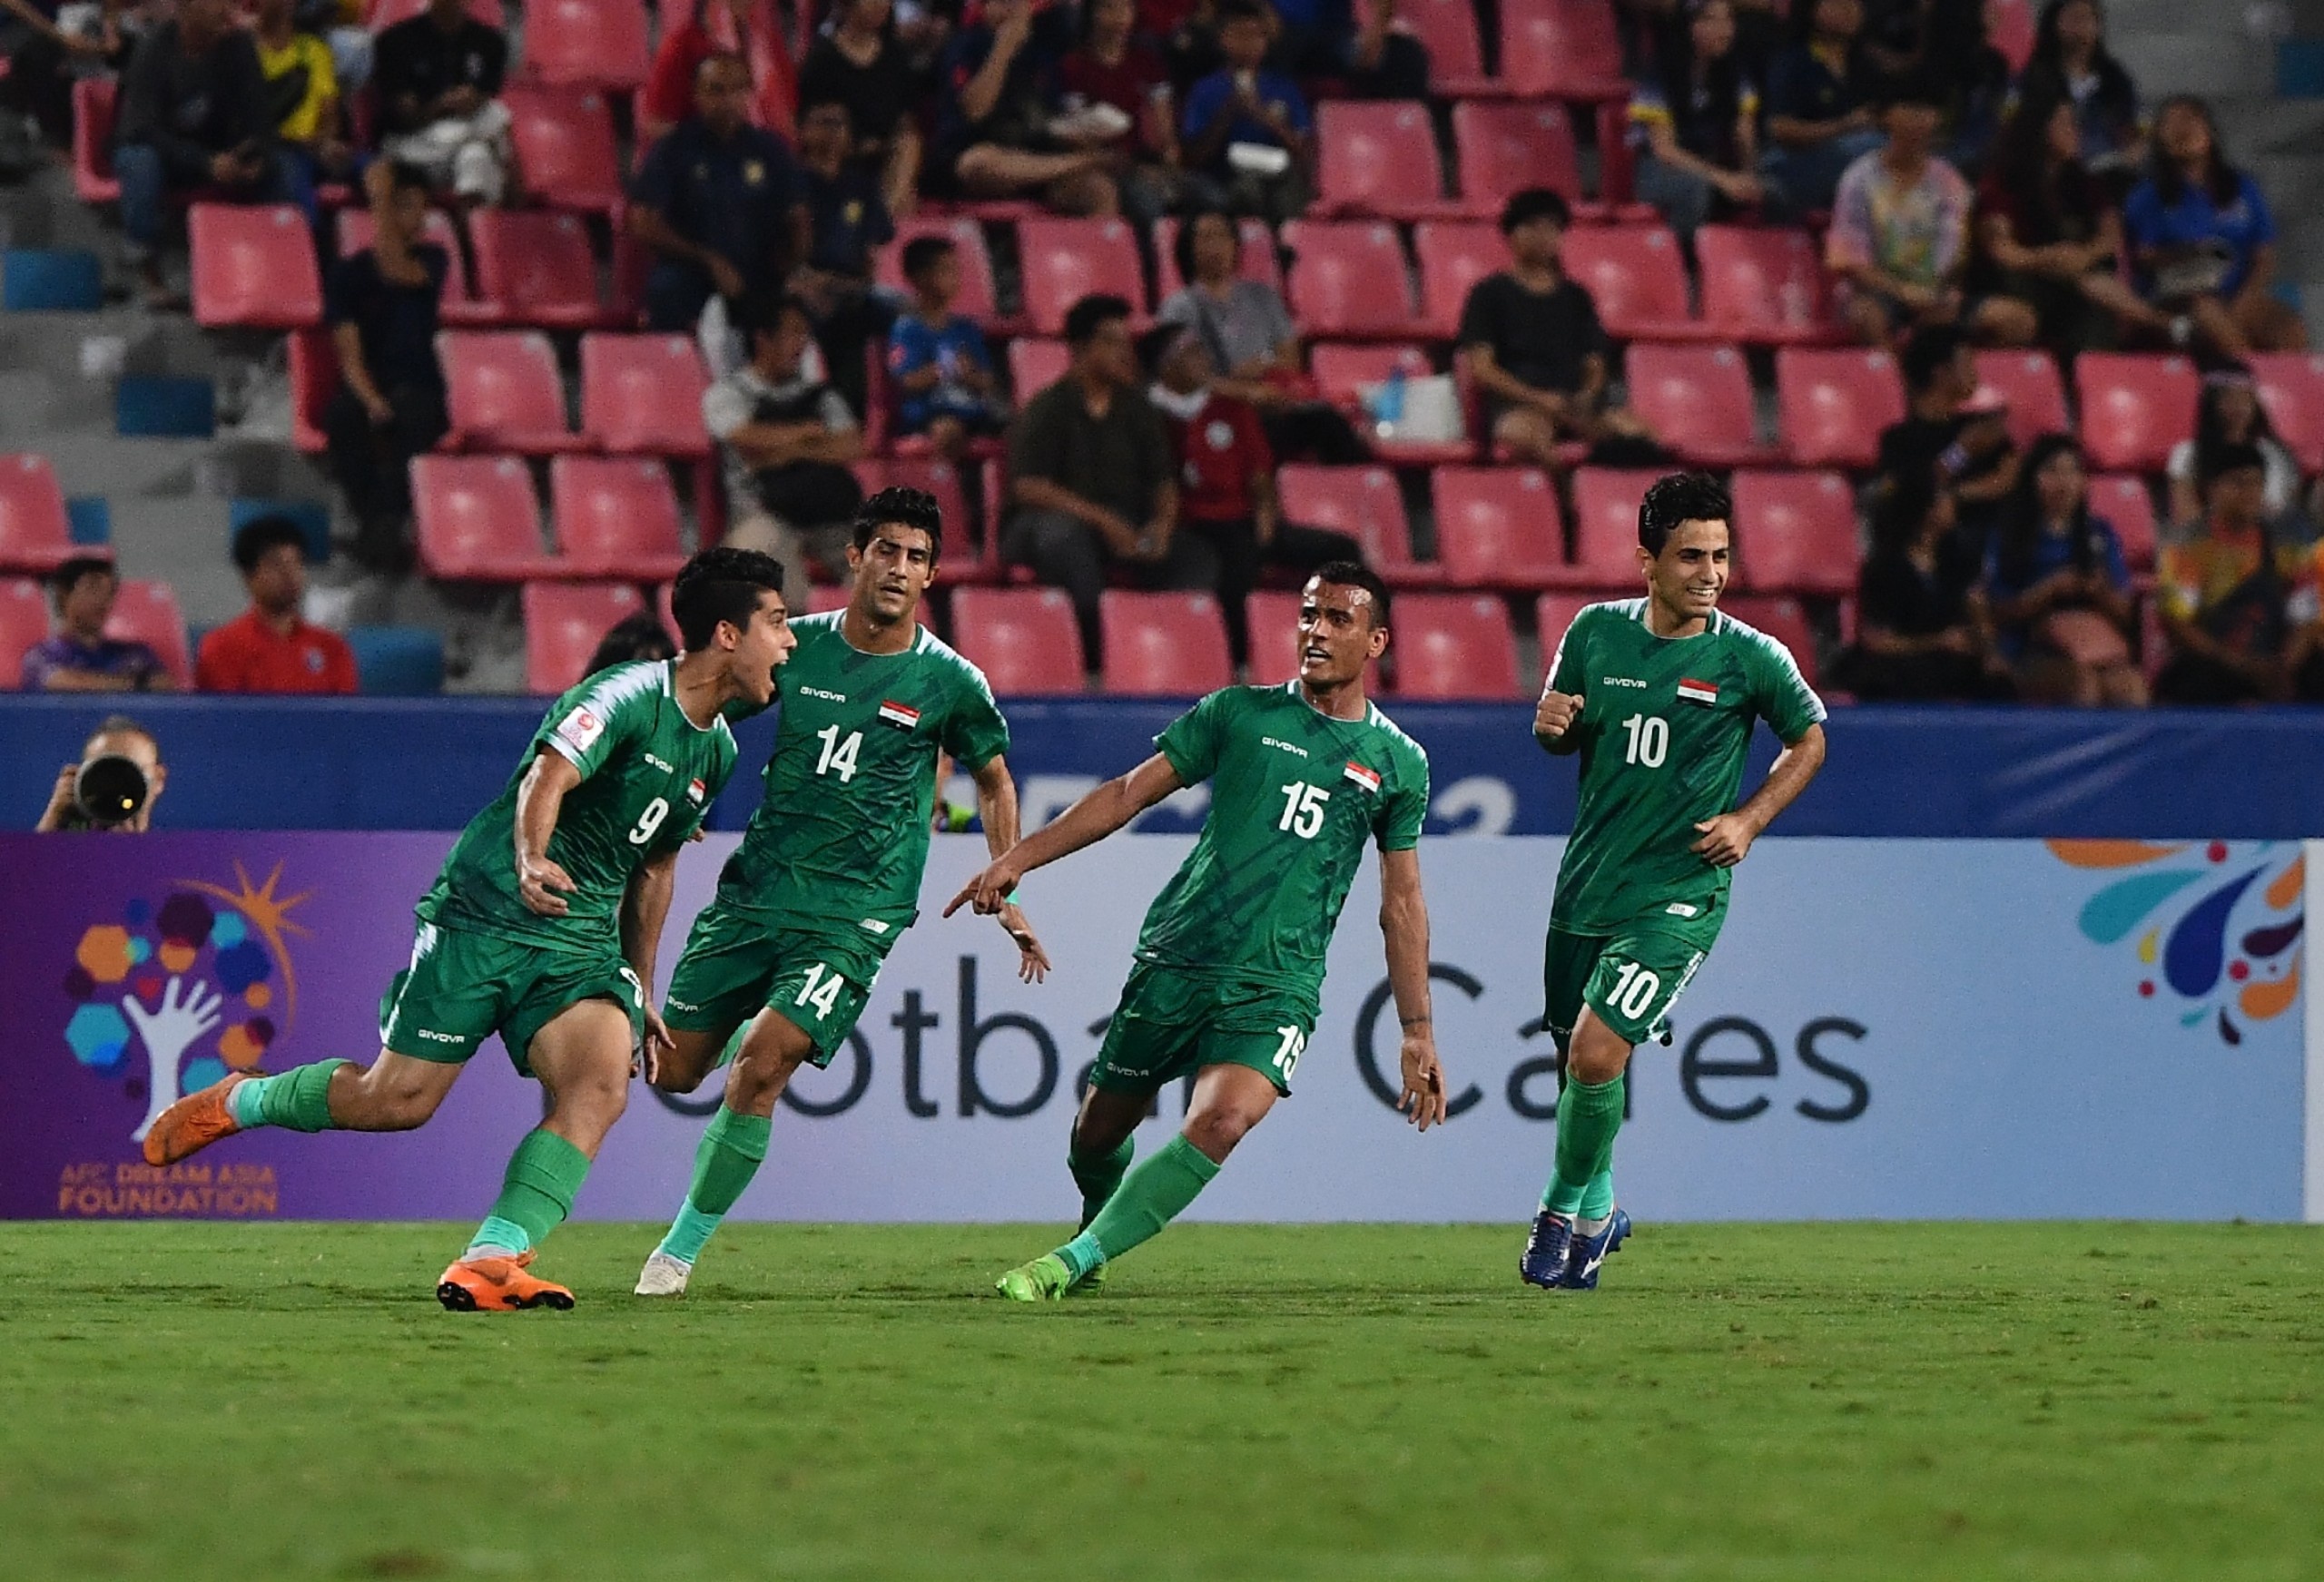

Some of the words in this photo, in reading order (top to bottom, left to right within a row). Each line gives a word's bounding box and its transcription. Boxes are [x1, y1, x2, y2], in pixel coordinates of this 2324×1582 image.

[800, 686, 846, 703] GIVOVA
[1603, 676, 1647, 689] GIVOVA
[815, 723, 863, 783] 14
[1261, 736, 1308, 759] GIVOVA
[1622, 712, 1669, 768] 10
[628, 796, 669, 844] 9
[1278, 781, 1331, 839] 15
[793, 962, 844, 1021] 14
[1605, 962, 1659, 1019] 10
[418, 1028, 465, 1044] GIVOVA
[217, 1163, 276, 1184] ASIA
[58, 1185, 279, 1214] FOUNDATION
